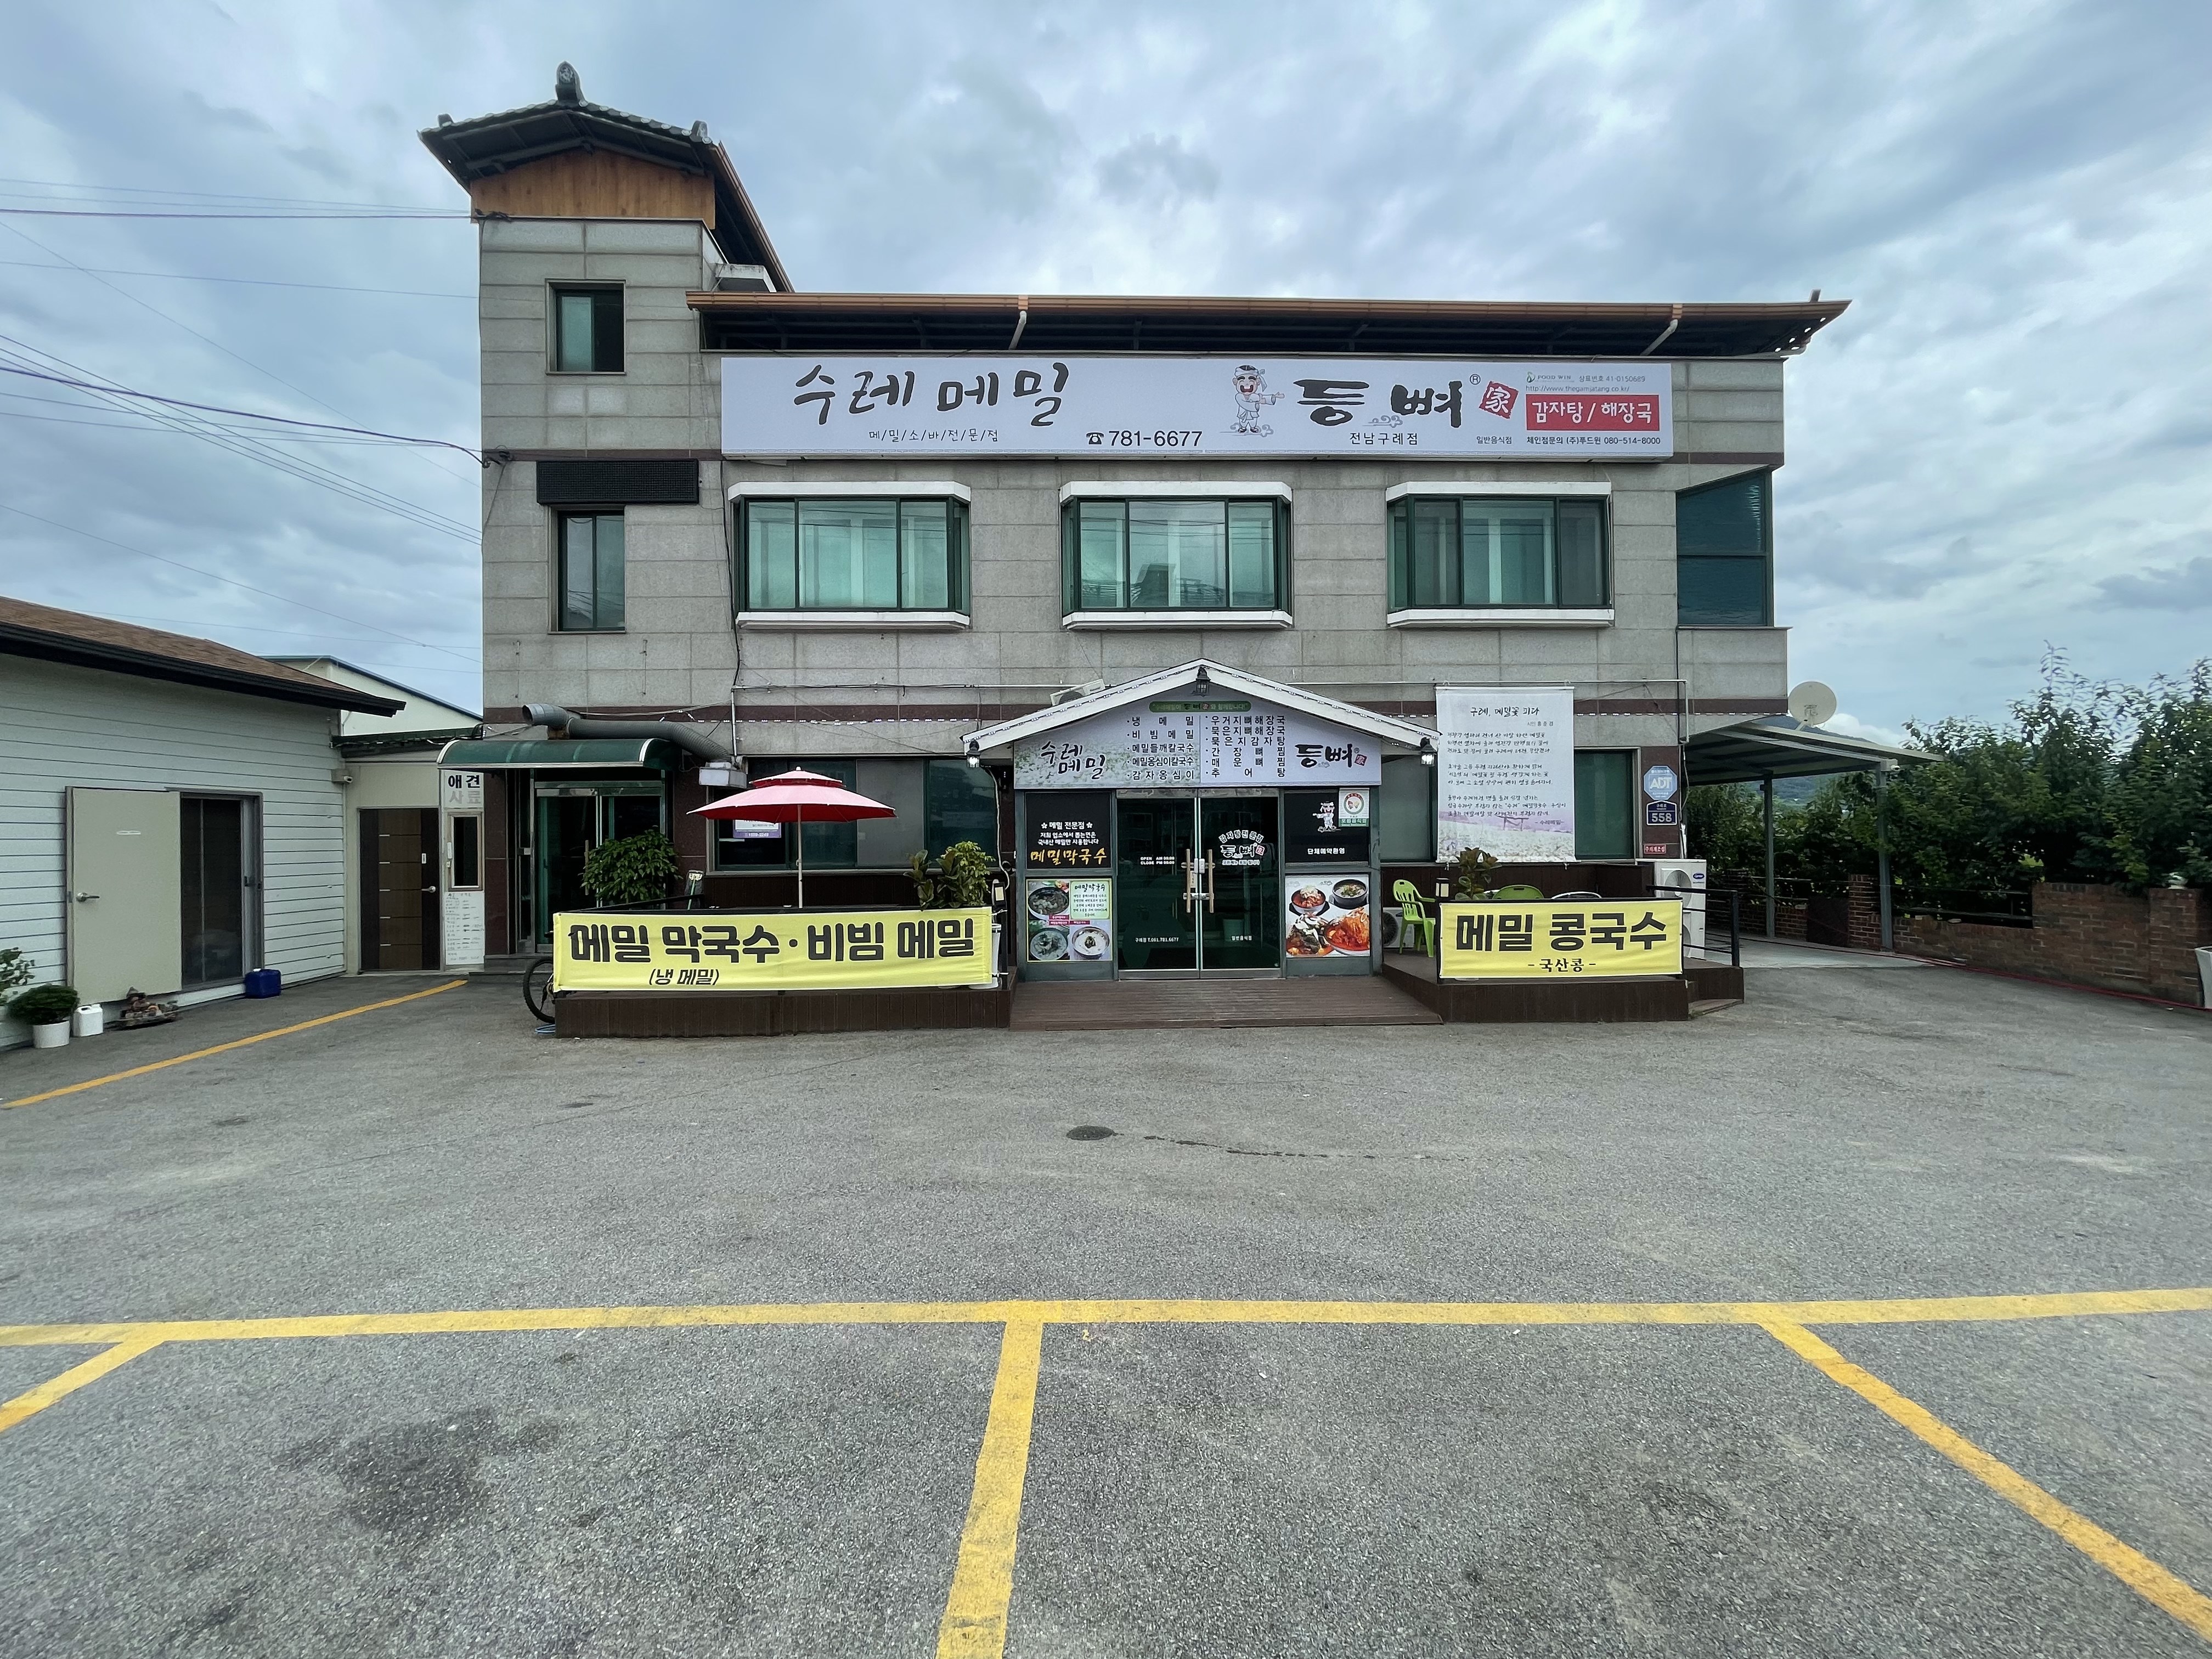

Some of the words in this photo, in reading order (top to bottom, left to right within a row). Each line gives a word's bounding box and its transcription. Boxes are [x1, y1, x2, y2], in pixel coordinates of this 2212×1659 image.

[794, 364, 916, 426] 수레
[937, 362, 1069, 427] 메밀
[1531, 401, 1583, 424] 감자탕
[1600, 402, 1652, 424] 해장국
[1108, 430, 1203, 448] 781-6677
[1349, 431, 1419, 446] 전남구례점
[1476, 436, 1513, 444] 일반음식점
[1526, 436, 1564, 445] 체인점문의
[1604, 437, 1661, 445] 080-514-8000
[1494, 706, 1520, 718] 메밀꽃
[1522, 707, 1540, 716] 피다
[1041, 741, 1084, 765] 수레
[1131, 743, 1195, 754] 메밀들깨칼국수
[1058, 754, 1106, 780] 메밀
[1131, 756, 1195, 767] 메밀옹심이칼국수
[448, 775, 481, 789] 애견
[1649, 776, 1673, 789] ADT
[1651, 812, 1673, 822] 558
[1049, 821, 1063, 830] 메밀
[1064, 821, 1085, 830] 전문점
[1030, 847, 1107, 866] 메밀막국수
[1074, 883, 1105, 893] 메밀막국수
[1455, 914, 1534, 952] 메밀
[1548, 911, 1667, 952] 콩국수
[569, 923, 652, 963] 메밀
[661, 924, 781, 963] 막국수
[807, 921, 884, 962] 비빔
[897, 917, 974, 960] 메밀
[1538, 957, 1584, 973] 국산콩
[648, 968, 674, 985] (냉
[676, 968, 720, 985] 메밀)
